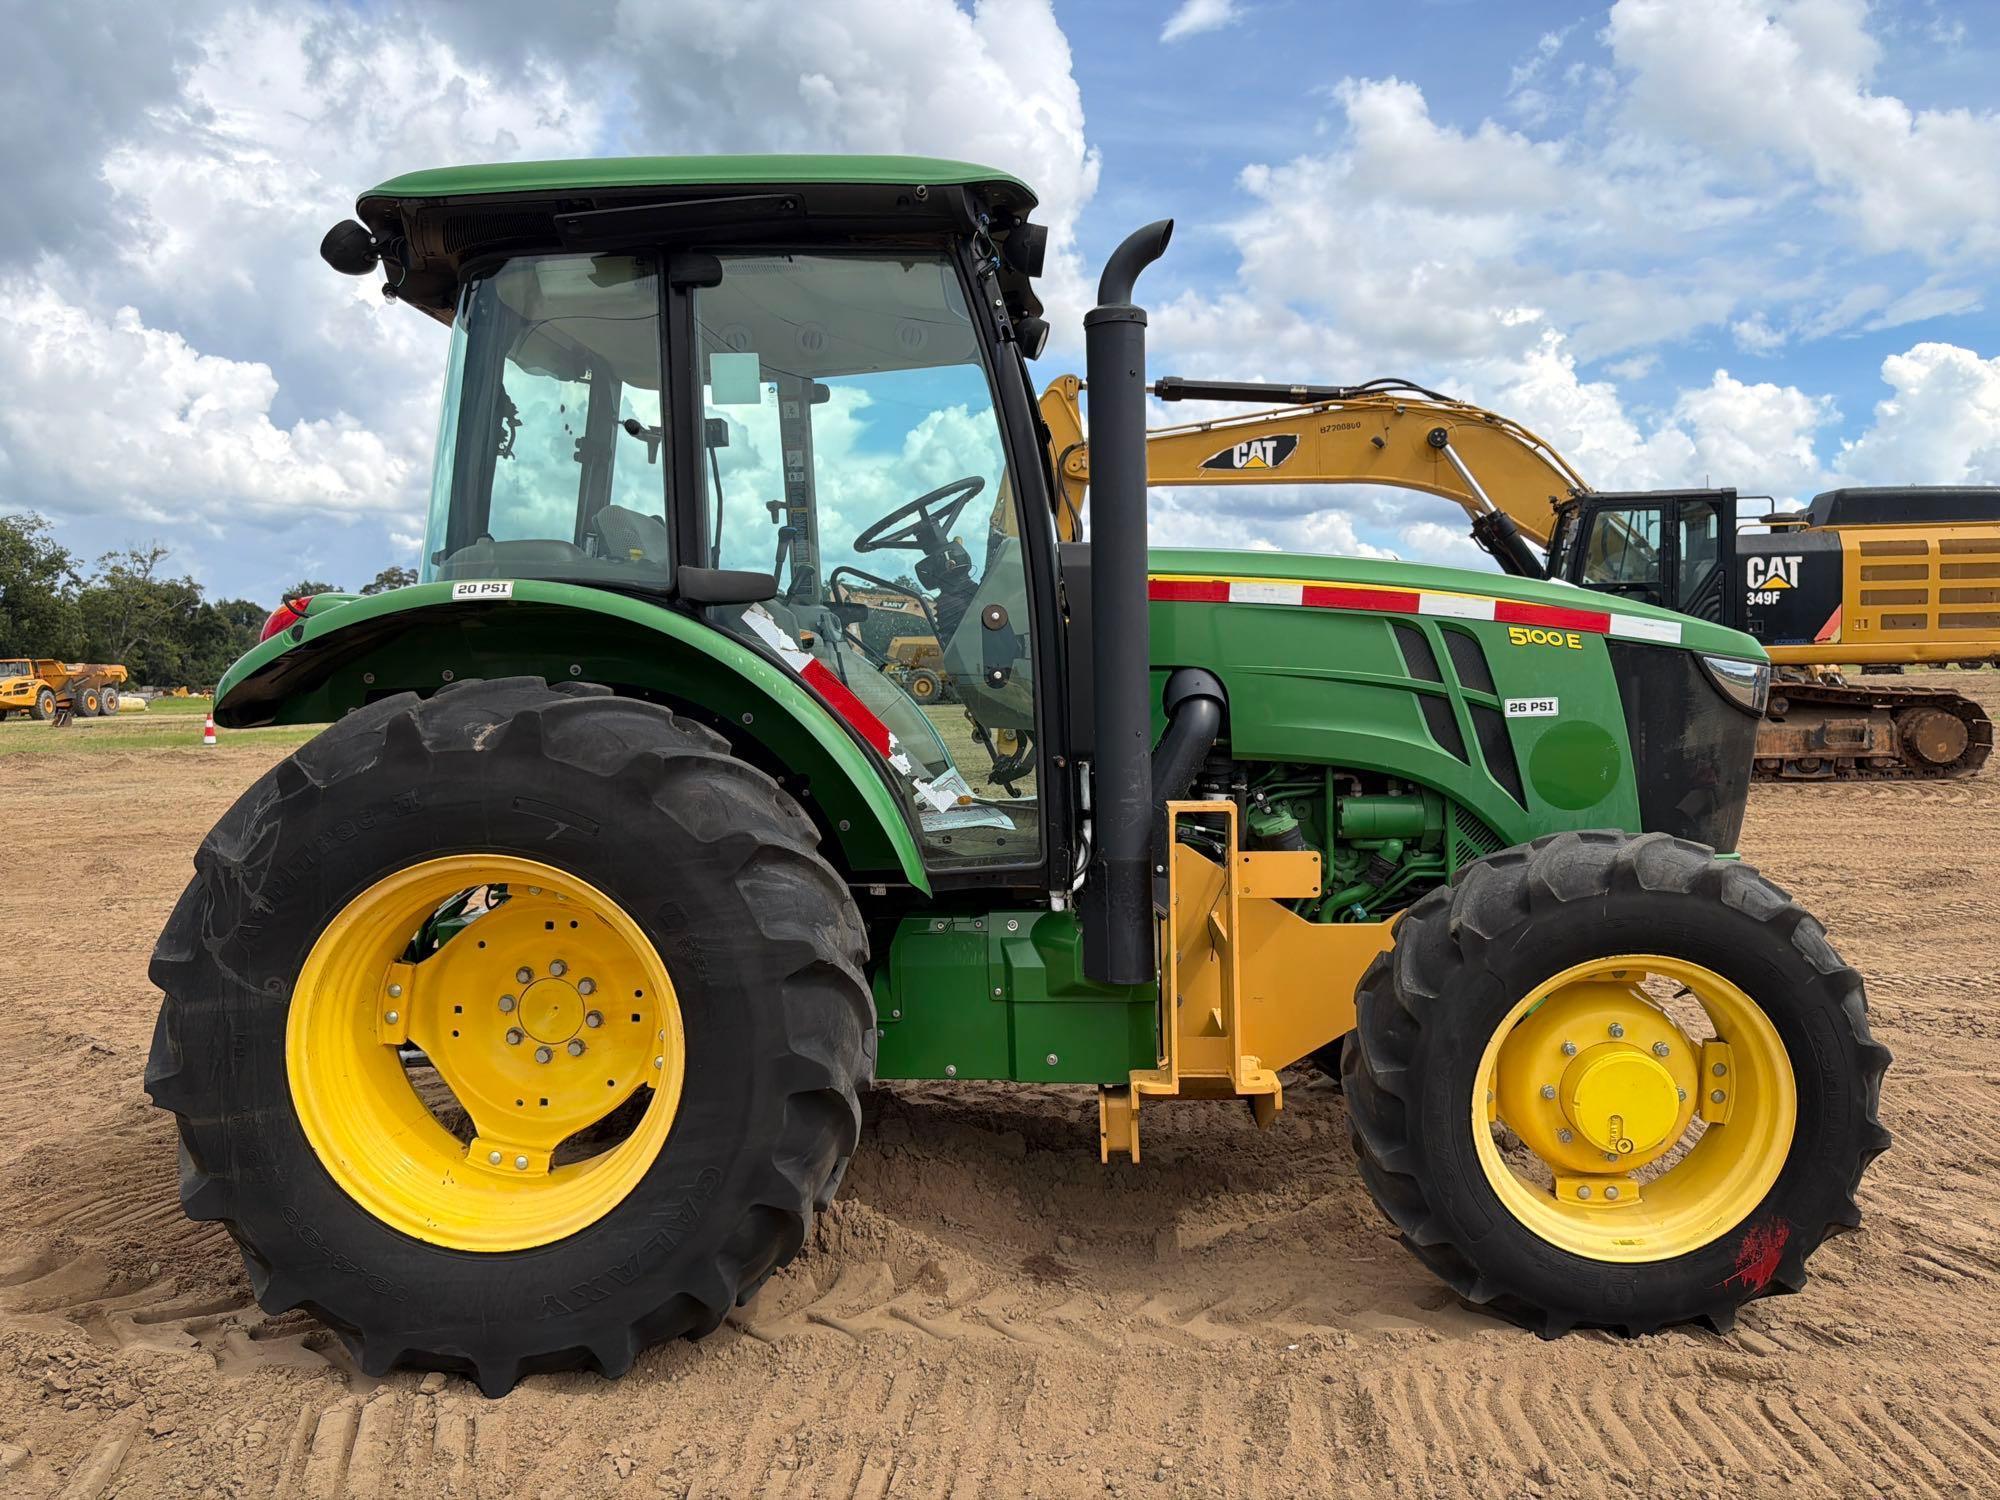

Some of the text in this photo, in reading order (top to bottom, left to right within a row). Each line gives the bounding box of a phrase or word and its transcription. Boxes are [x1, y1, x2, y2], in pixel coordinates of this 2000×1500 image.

[1232, 440, 1278, 468] CAT
[1746, 556, 1803, 589] CAT
[457, 583, 509, 594] 20 PSI
[1746, 591, 1781, 605] 349F
[1509, 701, 1554, 713] 26 PSI
[536, 1165, 722, 1322] GALAXY
